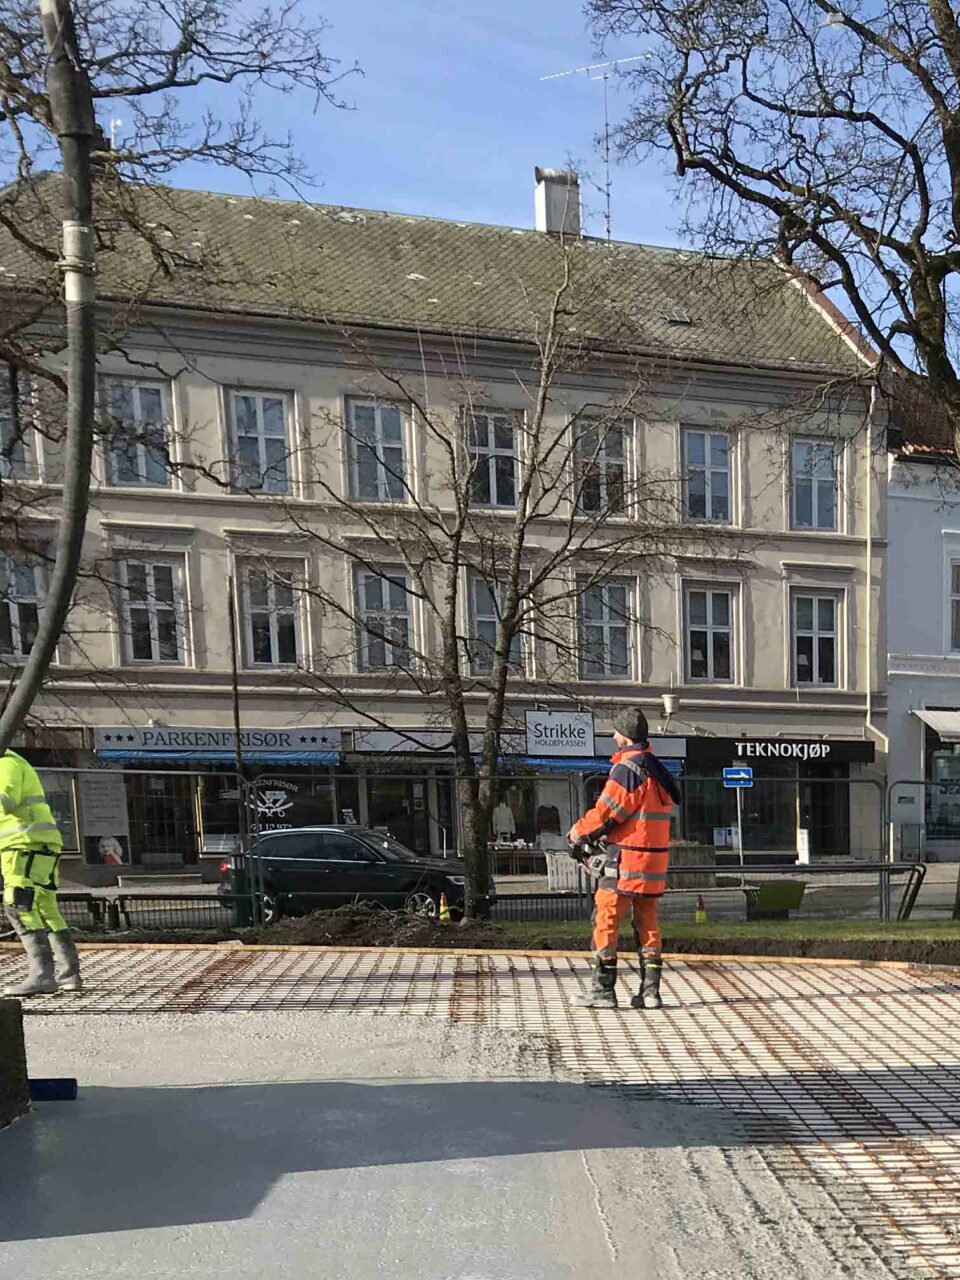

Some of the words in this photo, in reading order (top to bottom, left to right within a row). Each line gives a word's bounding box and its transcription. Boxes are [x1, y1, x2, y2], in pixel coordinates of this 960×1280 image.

[534, 722, 586, 739] Strikke
[142, 731, 292, 747] PARKENFRISØR
[534, 739, 587, 747] HOLDEPLASSEN
[735, 742, 831, 760] TEKNOKJØP
